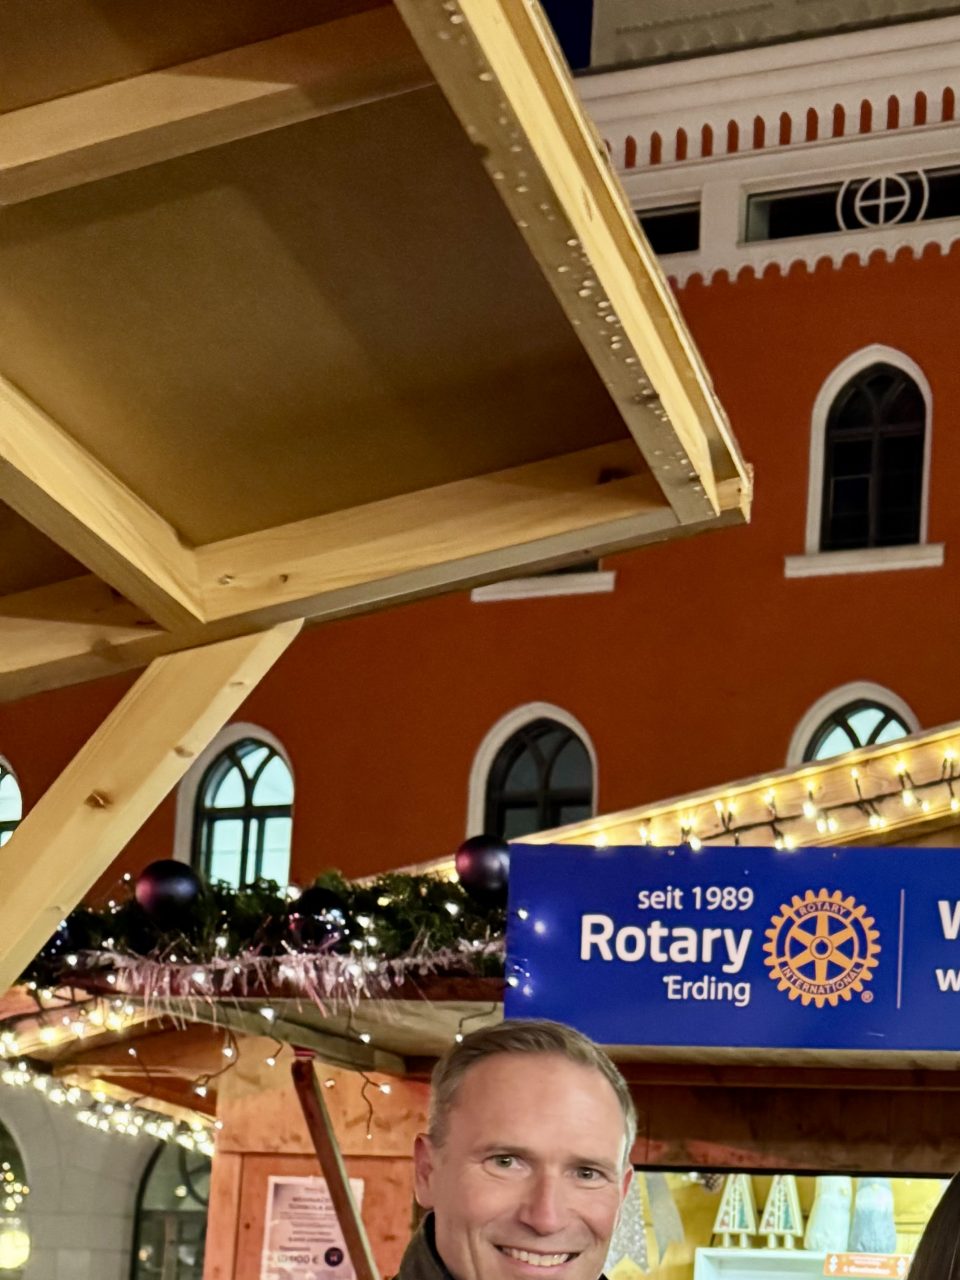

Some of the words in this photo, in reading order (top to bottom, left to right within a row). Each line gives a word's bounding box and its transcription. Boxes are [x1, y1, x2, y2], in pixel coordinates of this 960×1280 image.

[638, 885, 684, 910] seit
[691, 886, 754, 911] 1989
[799, 901, 847, 916] ROTARY
[580, 914, 753, 974] Rotary
[666, 974, 751, 1008] Erding
[780, 965, 862, 995] INTERNATIONAL
